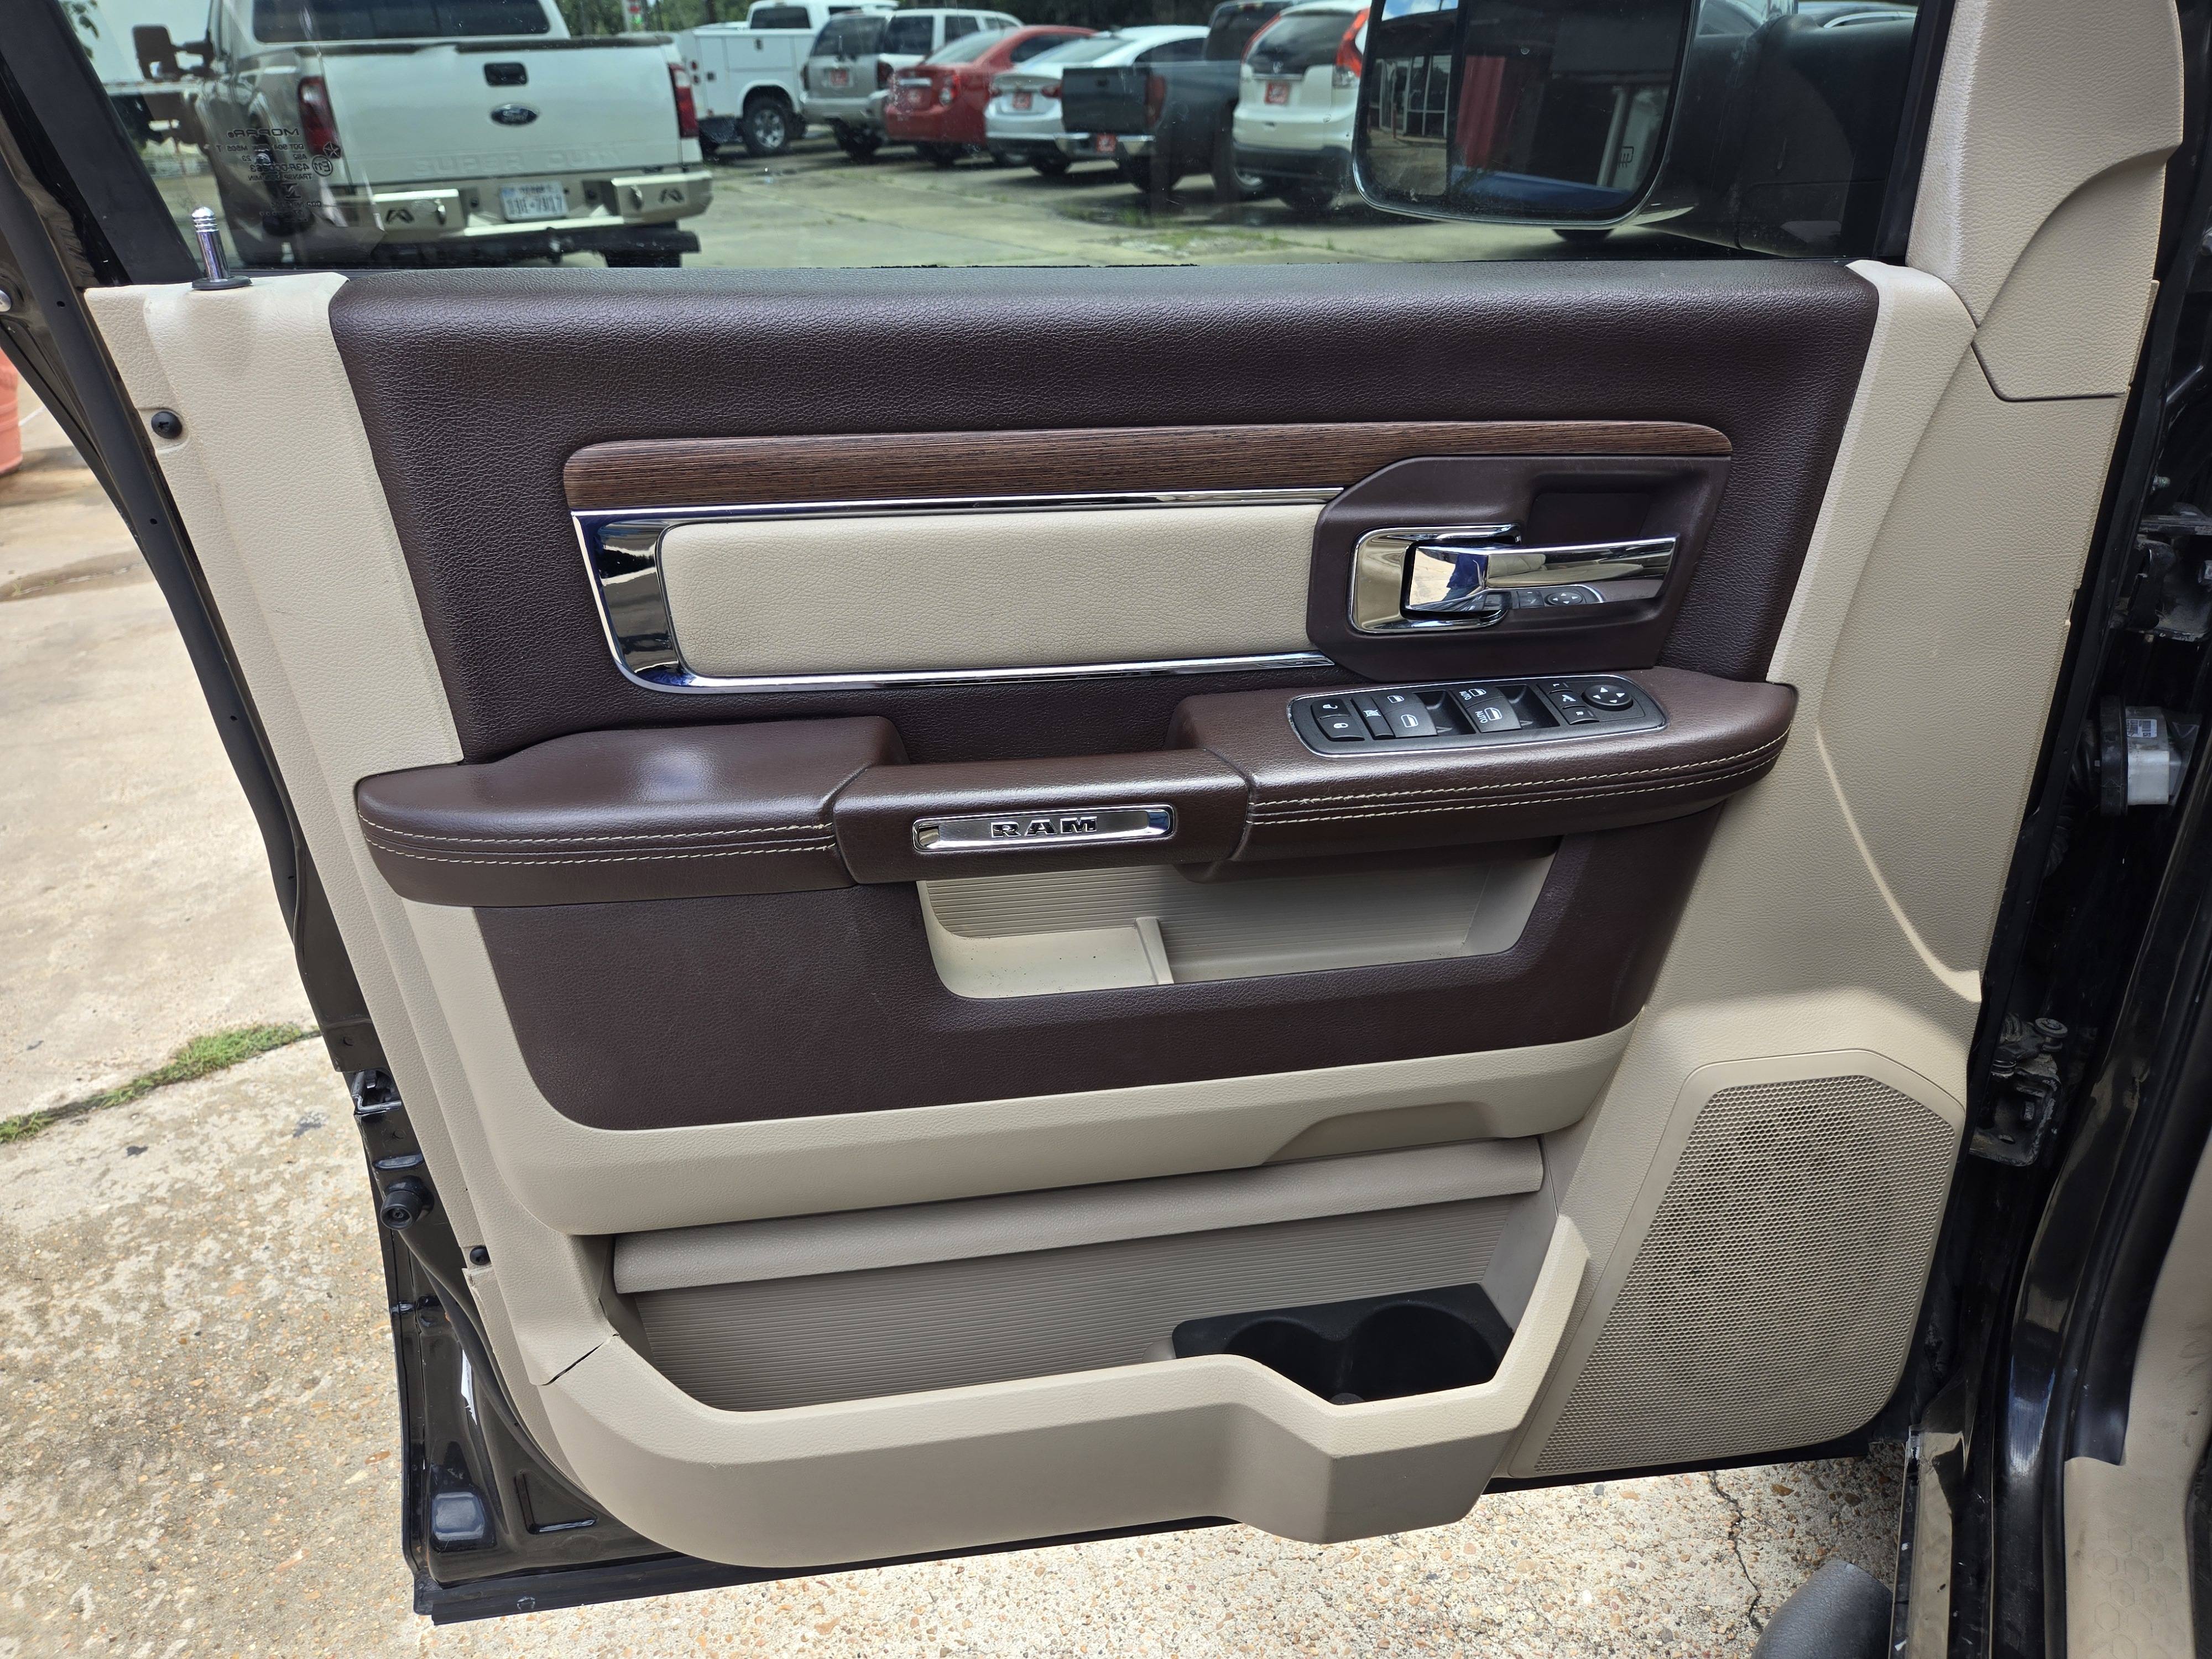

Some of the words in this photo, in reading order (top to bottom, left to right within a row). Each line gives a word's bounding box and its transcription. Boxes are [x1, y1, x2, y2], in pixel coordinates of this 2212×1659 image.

[1459, 691, 1472, 701] AUTO
[1475, 711, 1488, 723] AUTO
[990, 816, 1098, 838] RAM
